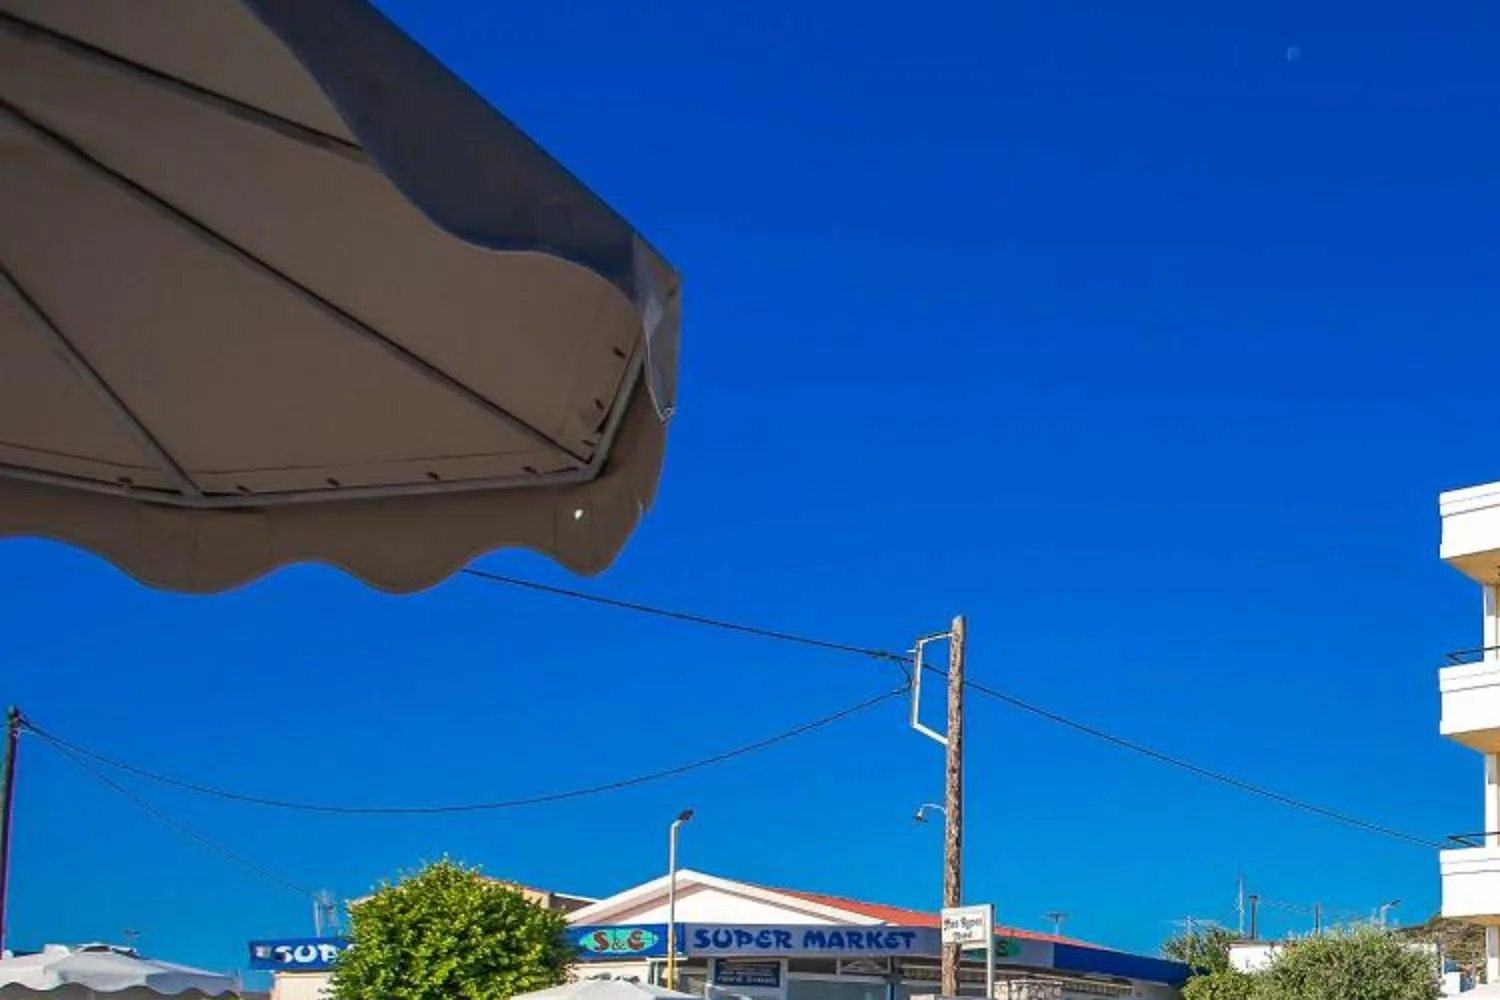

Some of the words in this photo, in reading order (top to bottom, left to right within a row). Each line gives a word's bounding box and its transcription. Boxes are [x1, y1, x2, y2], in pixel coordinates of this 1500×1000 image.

[693, 929, 793, 949] SUPER
[803, 929, 916, 949] MARKET
[275, 943, 355, 963] SUP
